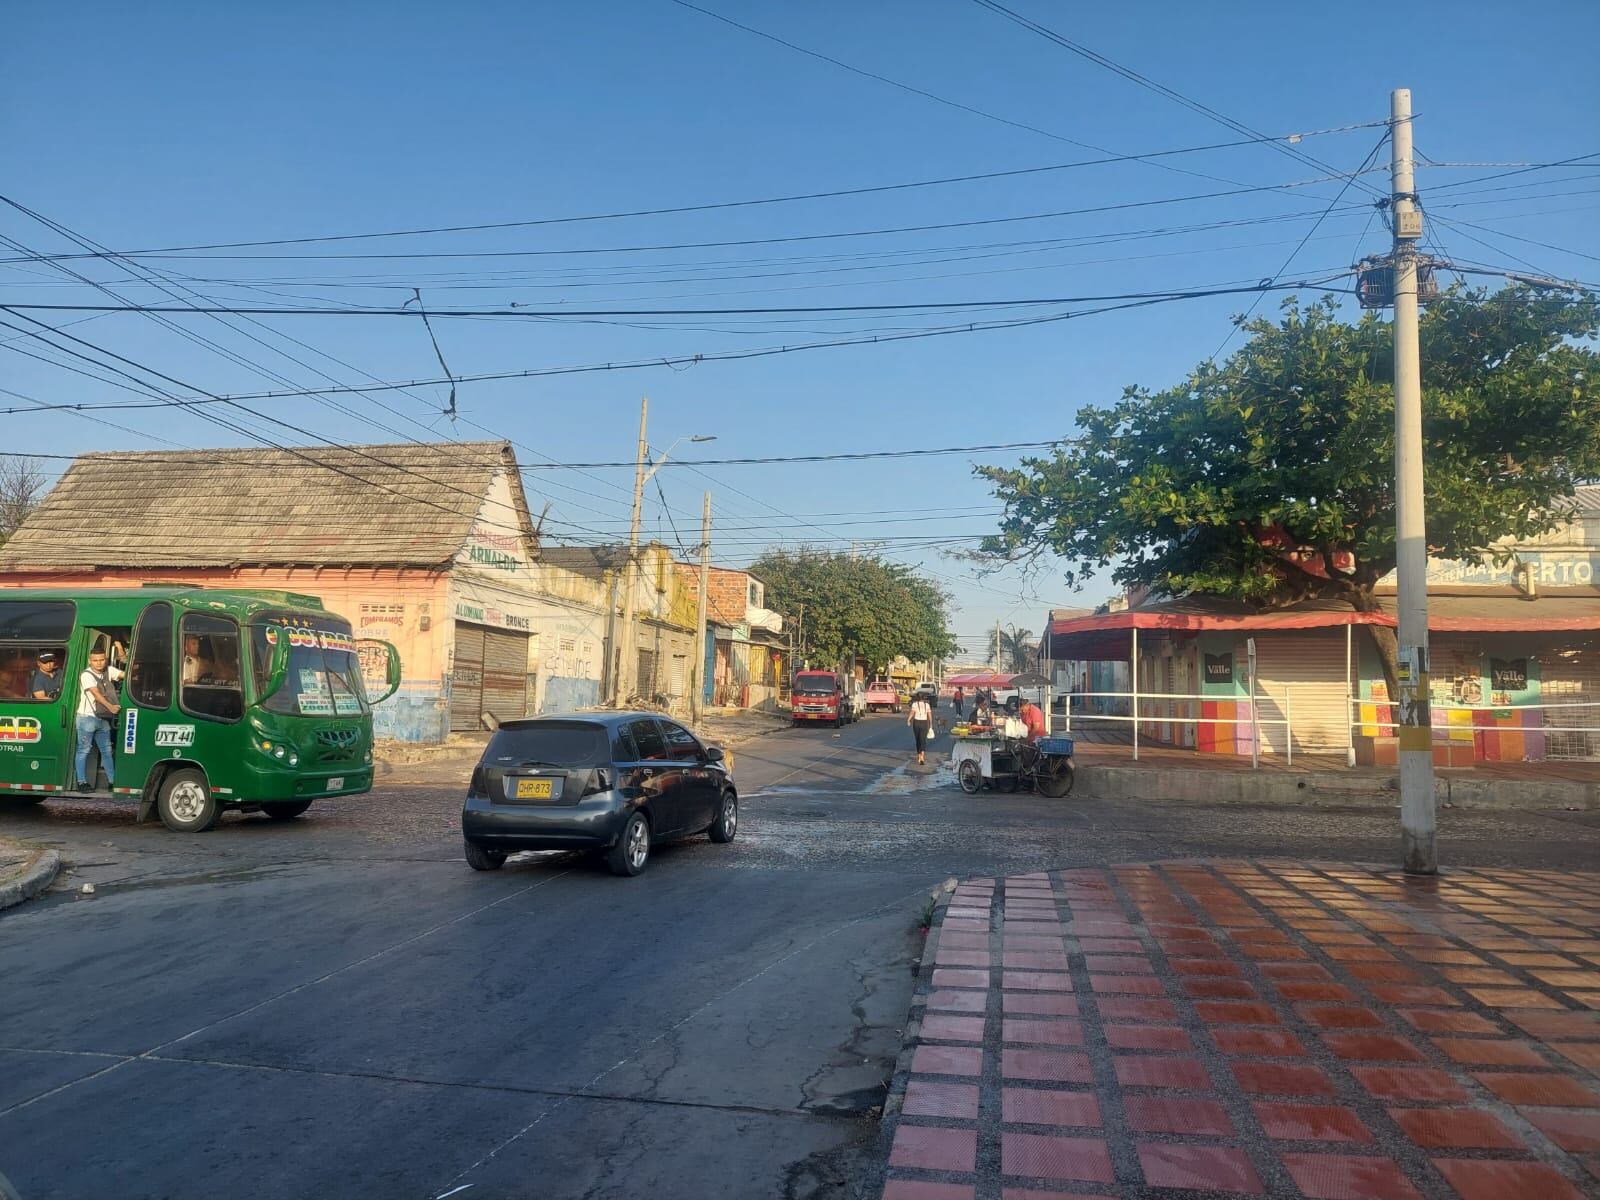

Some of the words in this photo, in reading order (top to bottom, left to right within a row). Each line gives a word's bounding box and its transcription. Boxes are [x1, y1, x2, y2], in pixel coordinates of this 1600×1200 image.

[469, 544, 517, 573] ARNALDO
[360, 616, 403, 628] COMPRAMOS
[505, 613, 529, 629] BRONCE
[1208, 664, 1231, 674] Valle
[1495, 670, 1525, 681] Valle
[126, 712, 136, 748] SENSOR
[156, 730, 178, 743] UYT
[178, 731, 195, 743] 441
